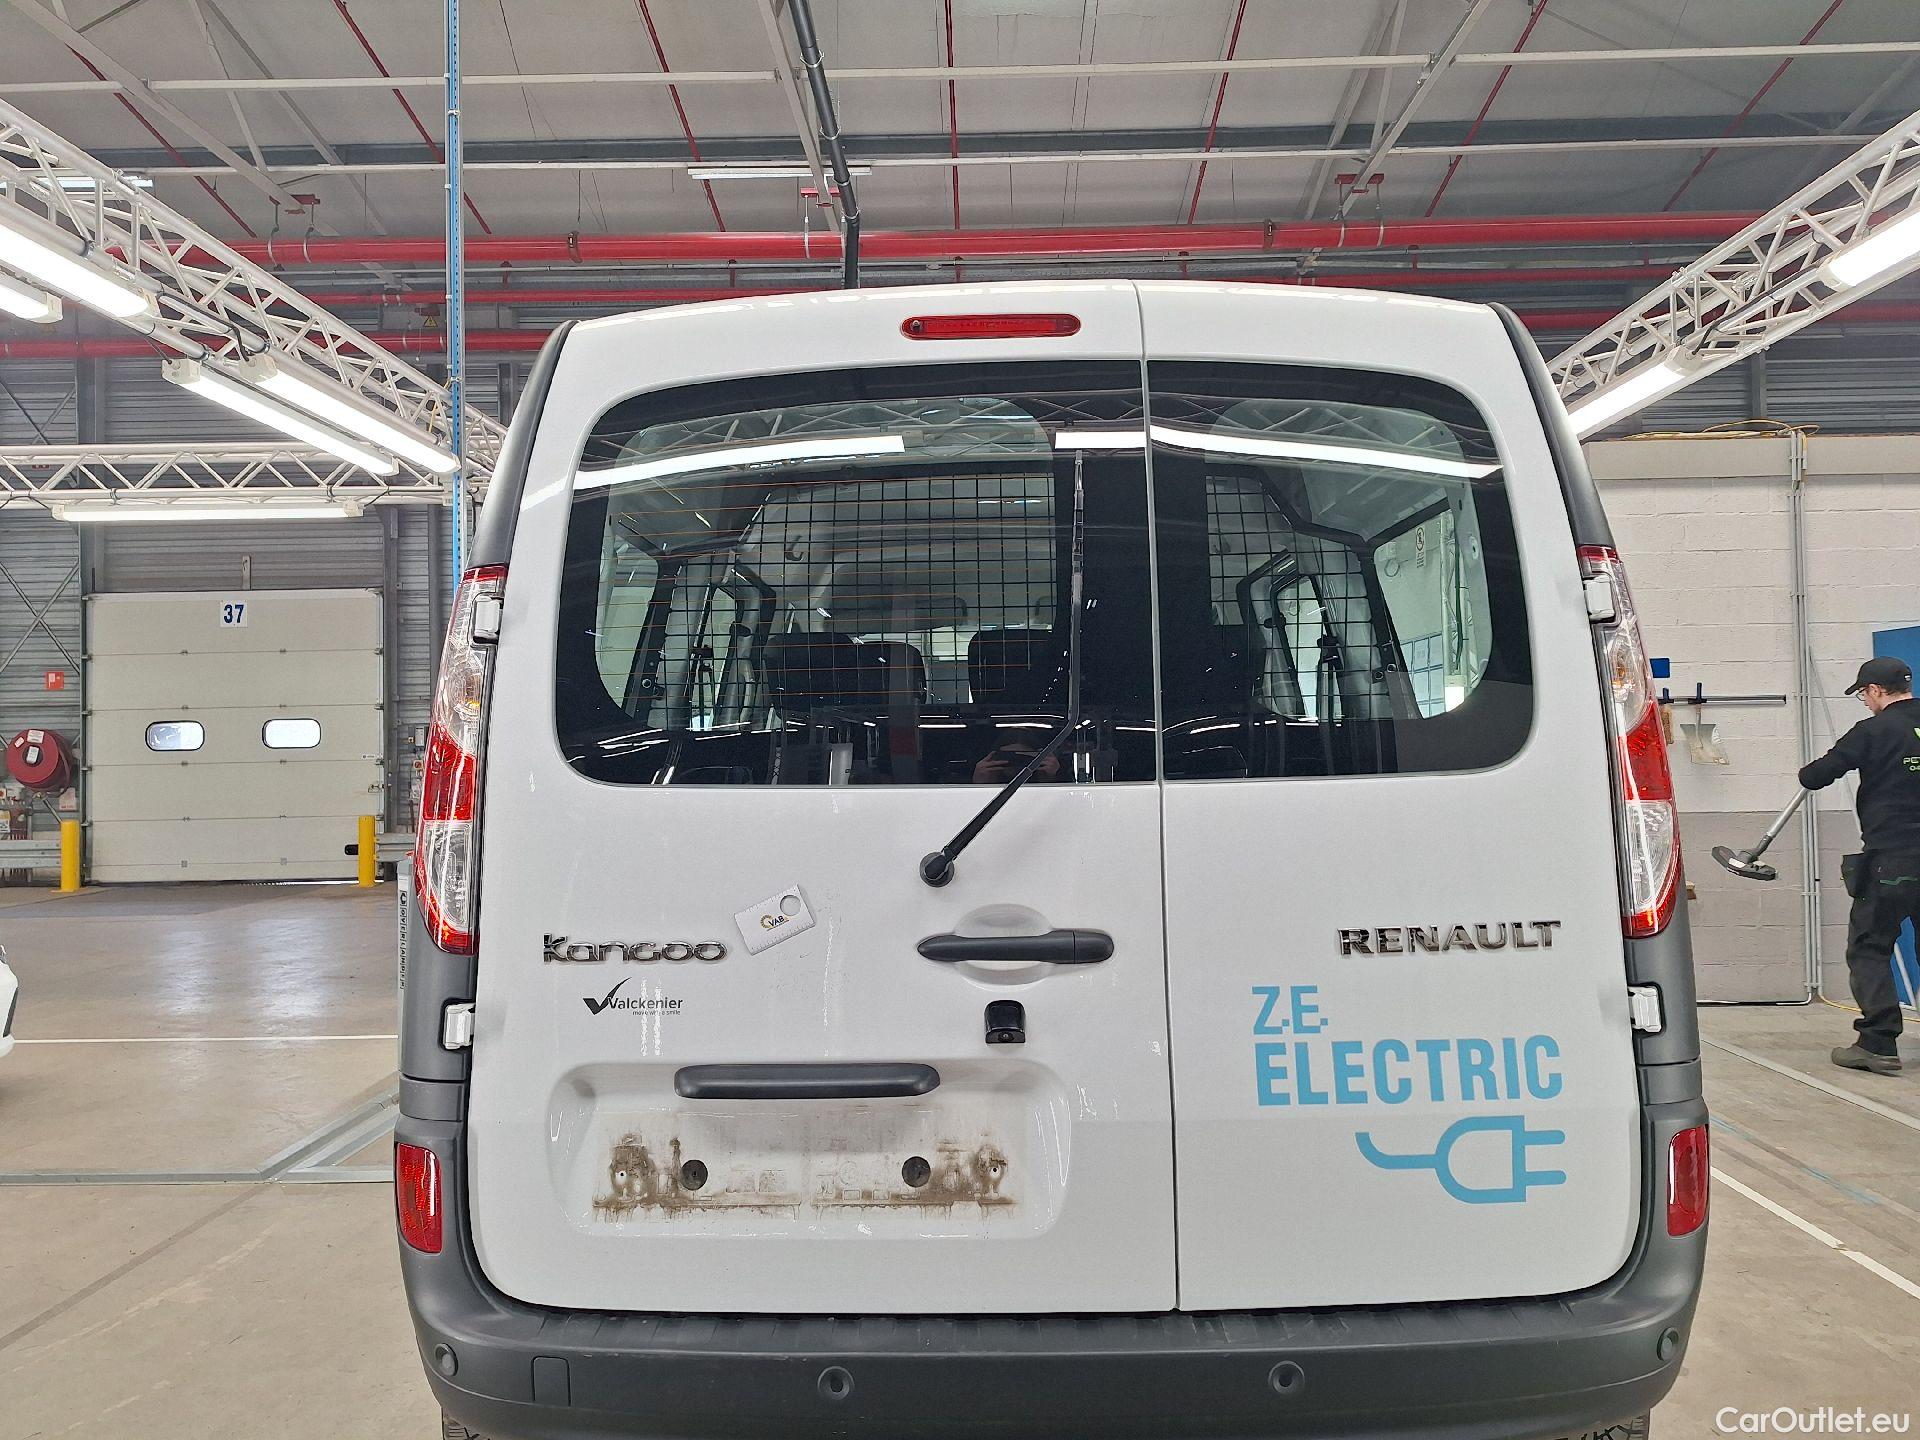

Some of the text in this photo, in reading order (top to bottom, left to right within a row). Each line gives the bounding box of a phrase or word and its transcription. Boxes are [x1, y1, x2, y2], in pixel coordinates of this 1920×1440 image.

[224, 604, 245, 624] 37
[1337, 920, 1561, 955] RENAULT
[608, 997, 682, 1009] Valckenier
[1252, 985, 1329, 1035] Z.E.
[1254, 1034, 1563, 1106] ELECTRIC
